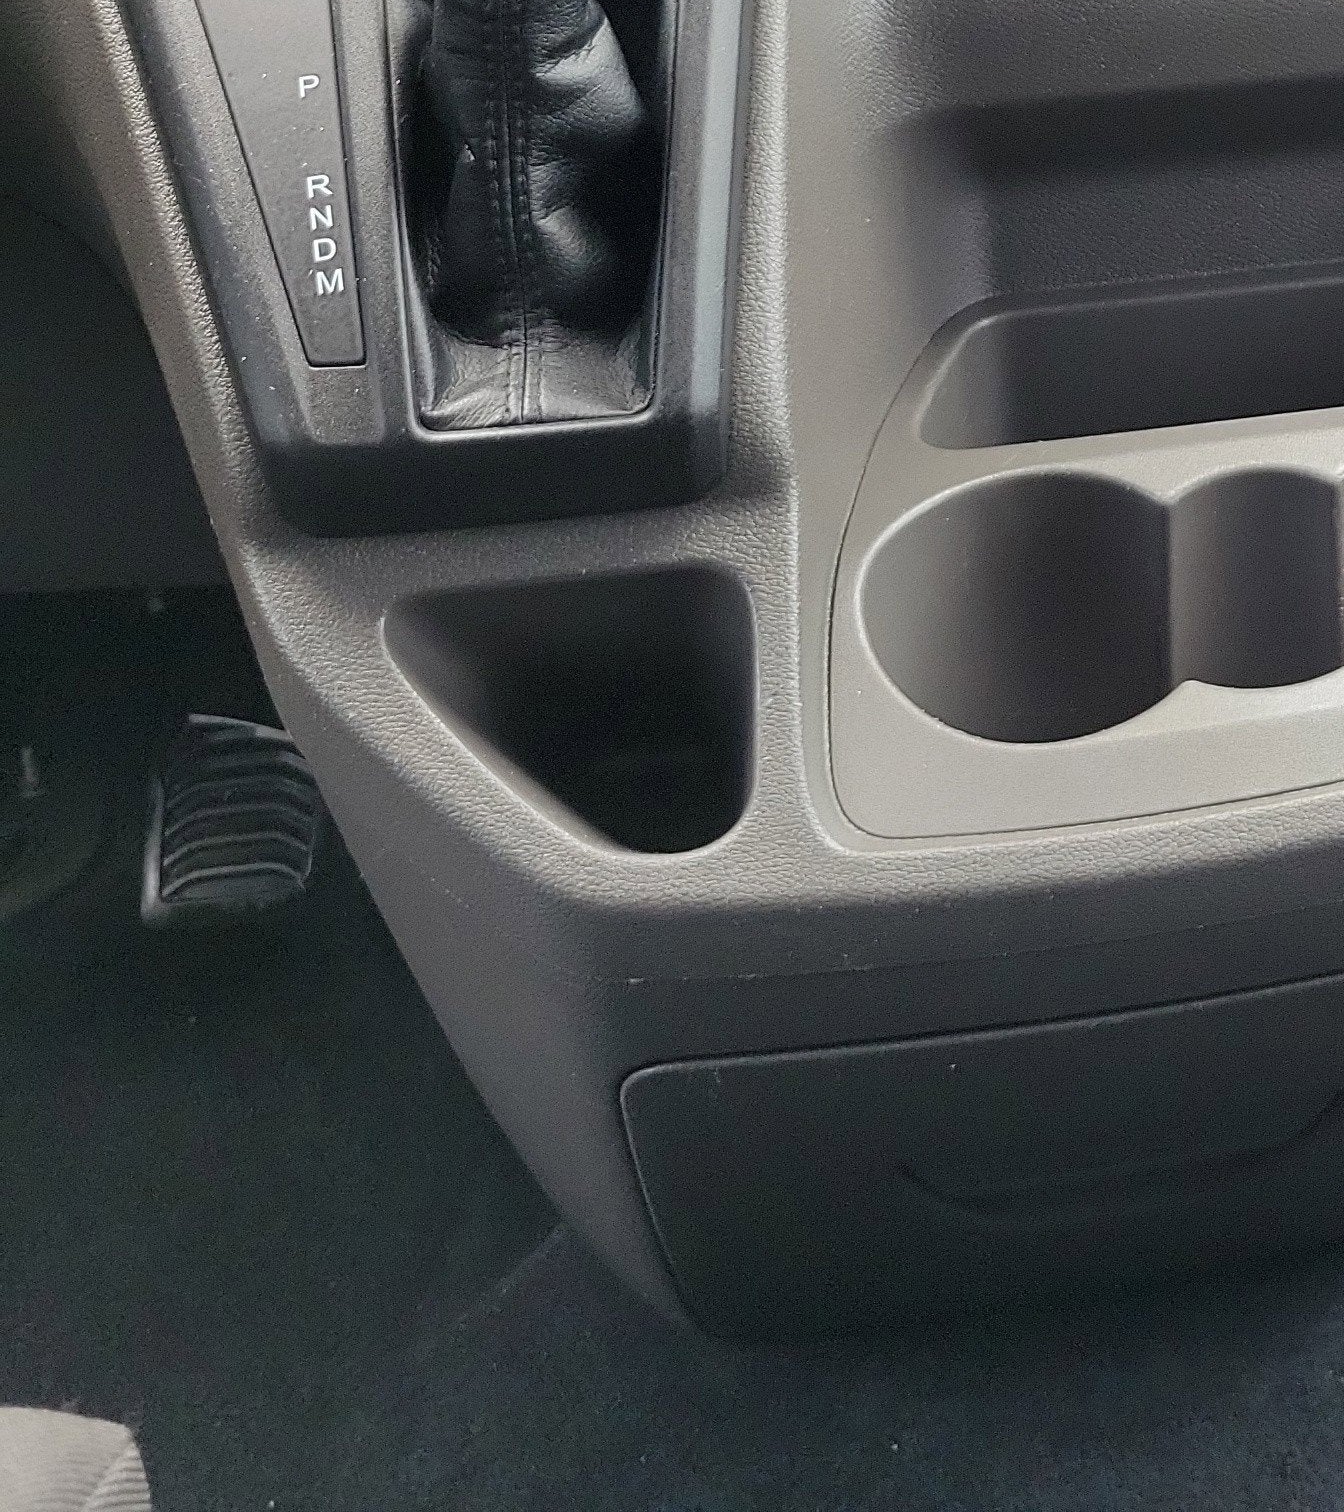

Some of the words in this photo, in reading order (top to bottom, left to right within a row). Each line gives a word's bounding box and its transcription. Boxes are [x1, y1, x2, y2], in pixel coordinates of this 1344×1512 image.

[299, 75, 320, 98] P
[307, 174, 333, 198] R
[309, 204, 333, 231] N
[312, 237, 337, 263] D
[316, 268, 345, 295] M
